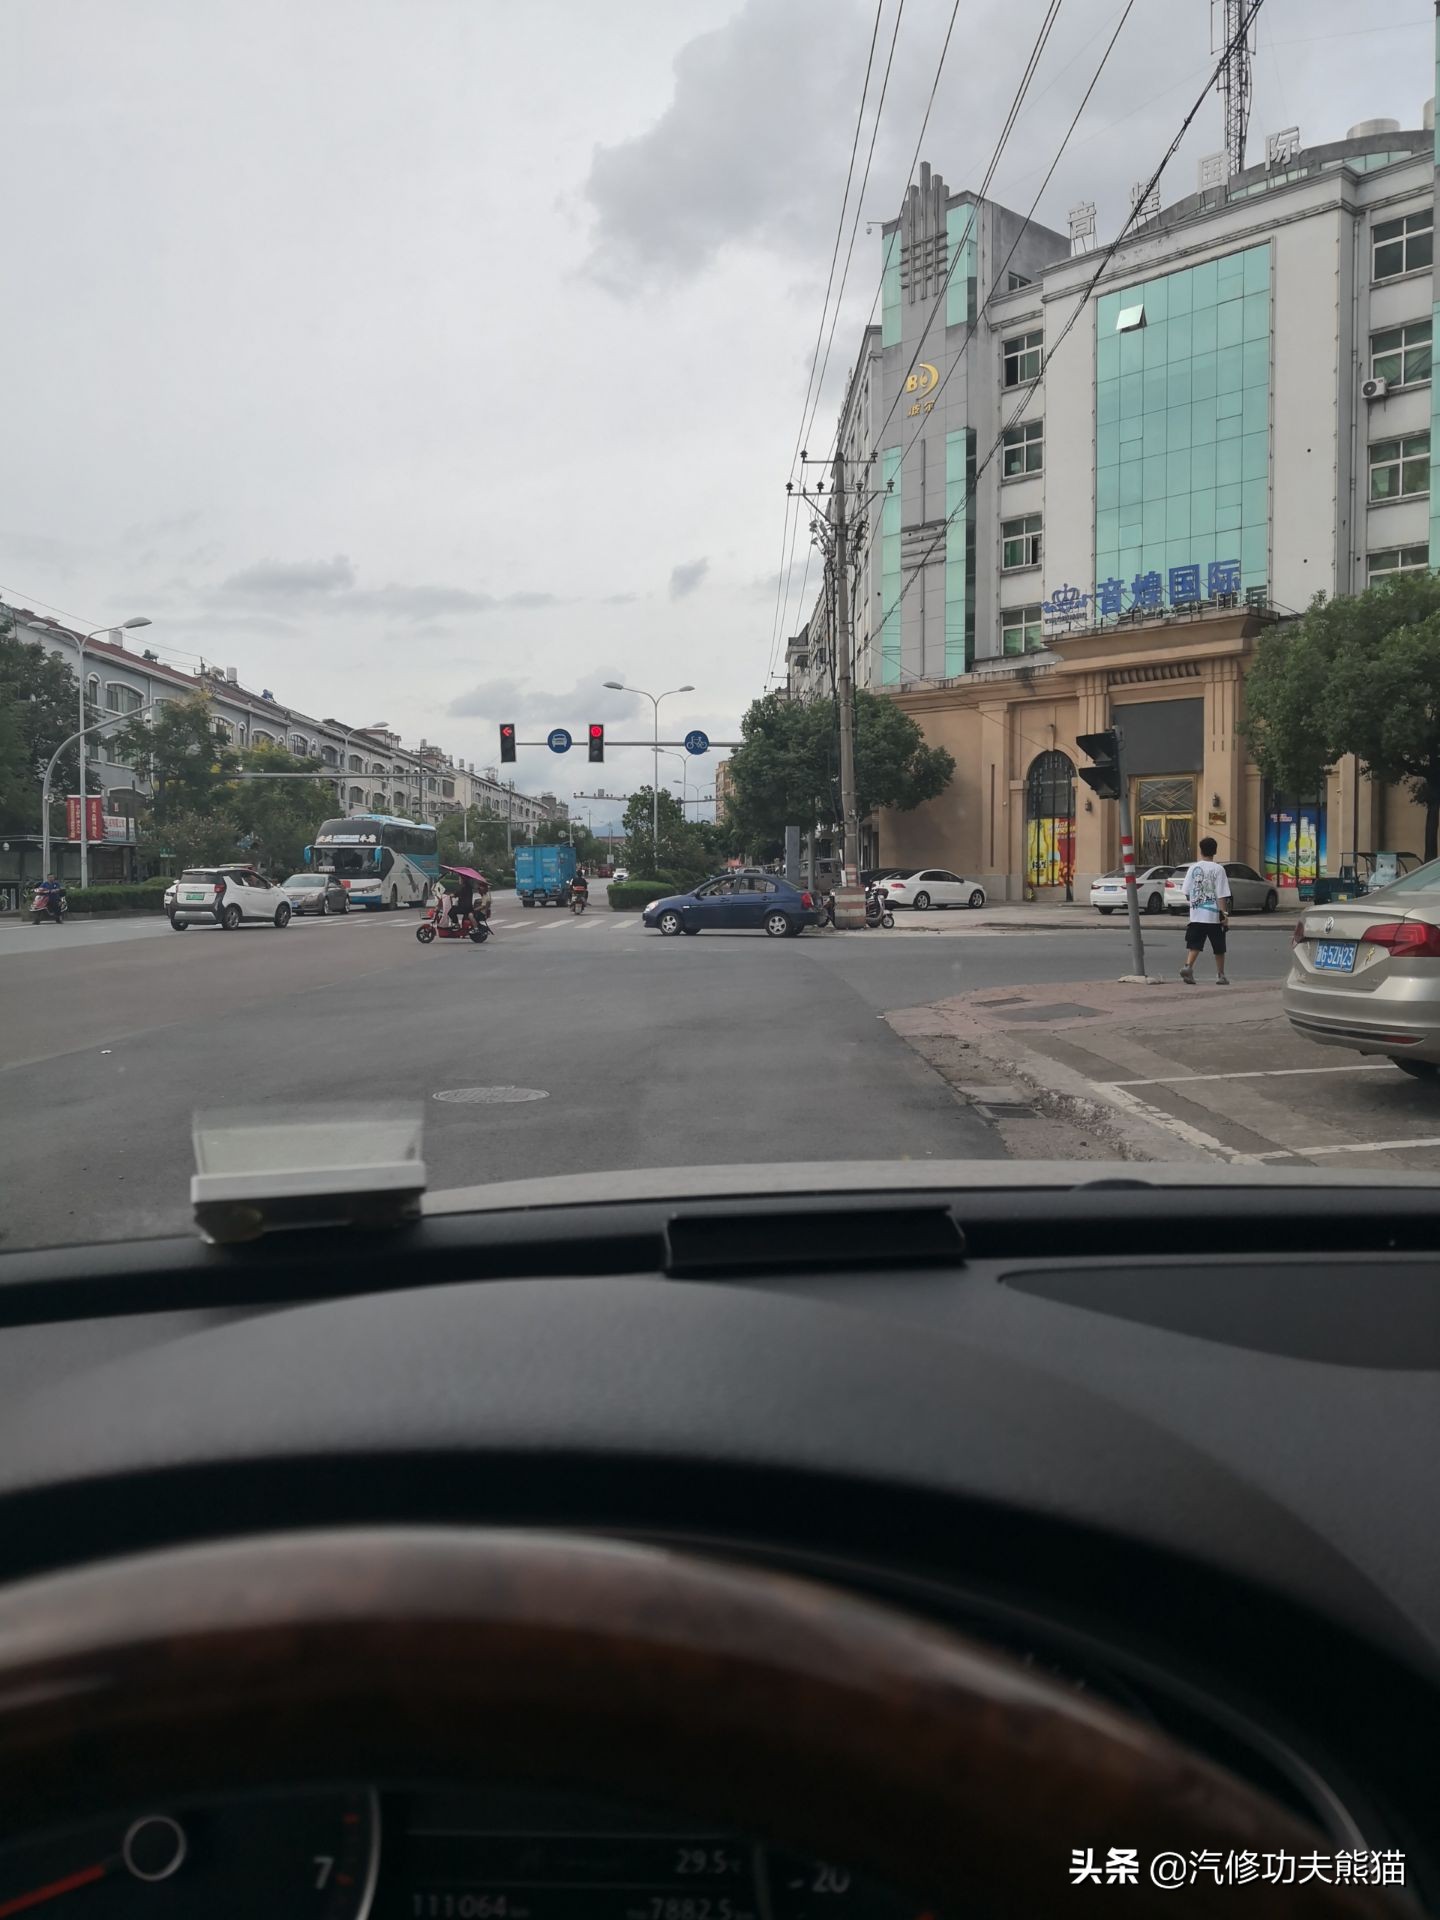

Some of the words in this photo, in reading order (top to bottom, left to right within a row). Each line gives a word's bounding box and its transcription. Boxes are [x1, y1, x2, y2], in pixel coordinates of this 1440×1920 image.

[1095, 559, 1242, 615] 音煌国际
[312, 1854, 336, 1891] 7
